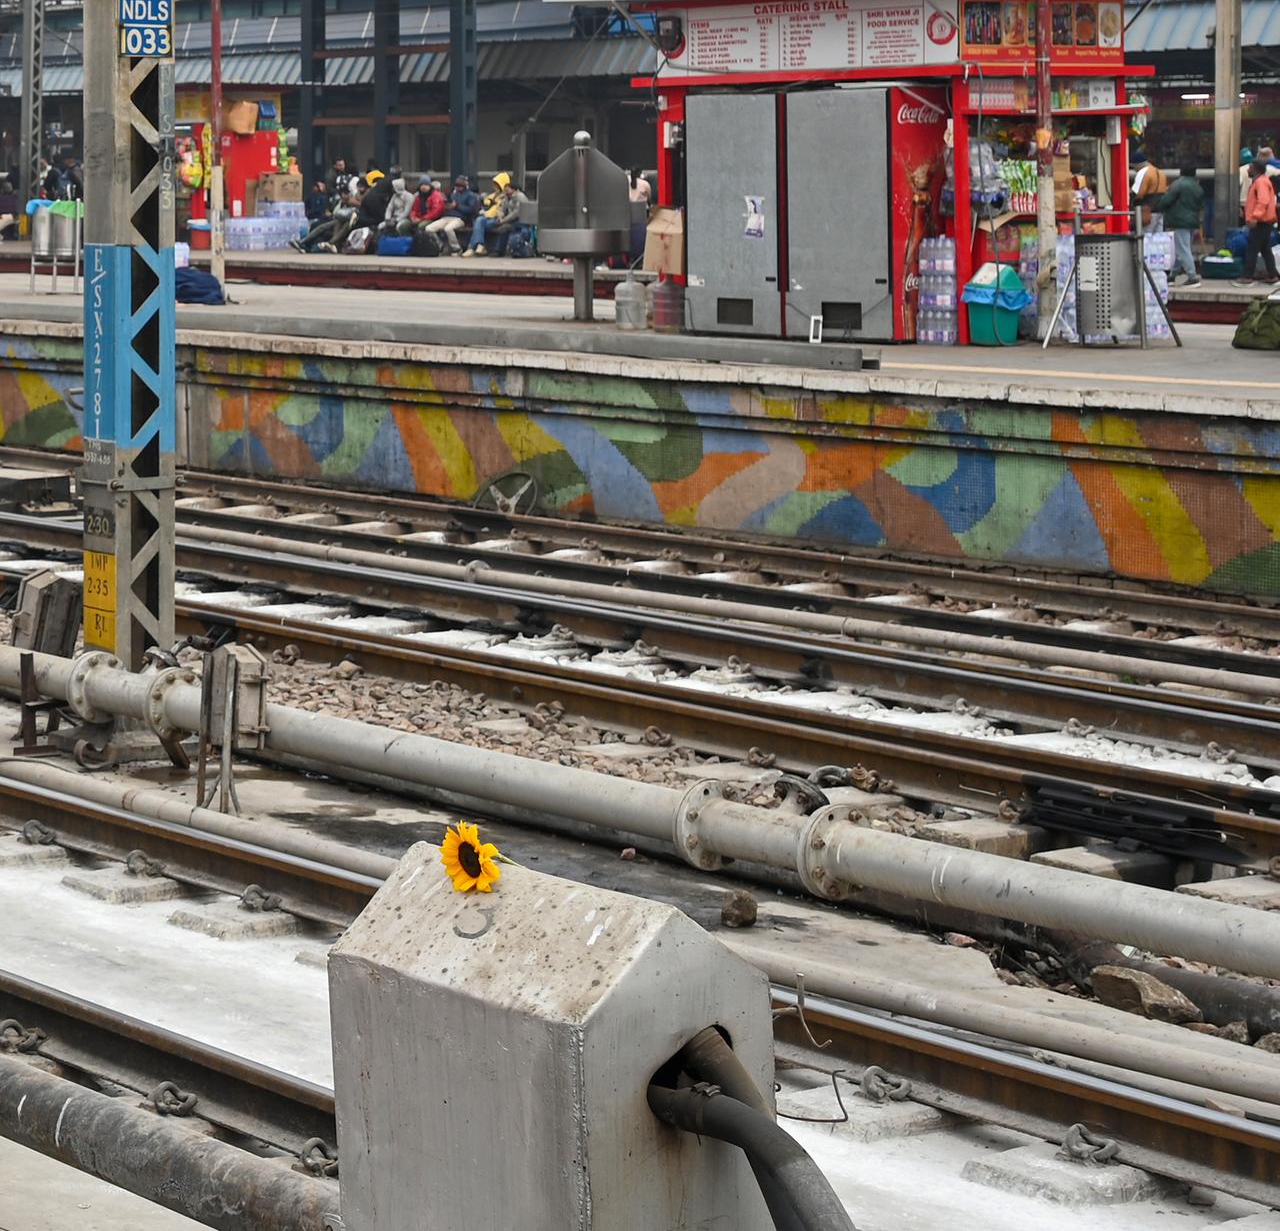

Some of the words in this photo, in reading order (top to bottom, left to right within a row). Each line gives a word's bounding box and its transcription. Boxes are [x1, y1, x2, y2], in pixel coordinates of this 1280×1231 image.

[122, 0, 169, 21] NDLS
[753, 2, 810, 16] CATERING
[814, 0, 849, 11] STALL
[886, 9, 911, 17] SHYAM
[867, 20, 887, 28] FOOD
[889, 18, 920, 27] SERVICE
[121, 28, 171, 55] 1033
[91, 553, 108, 571] IMP
